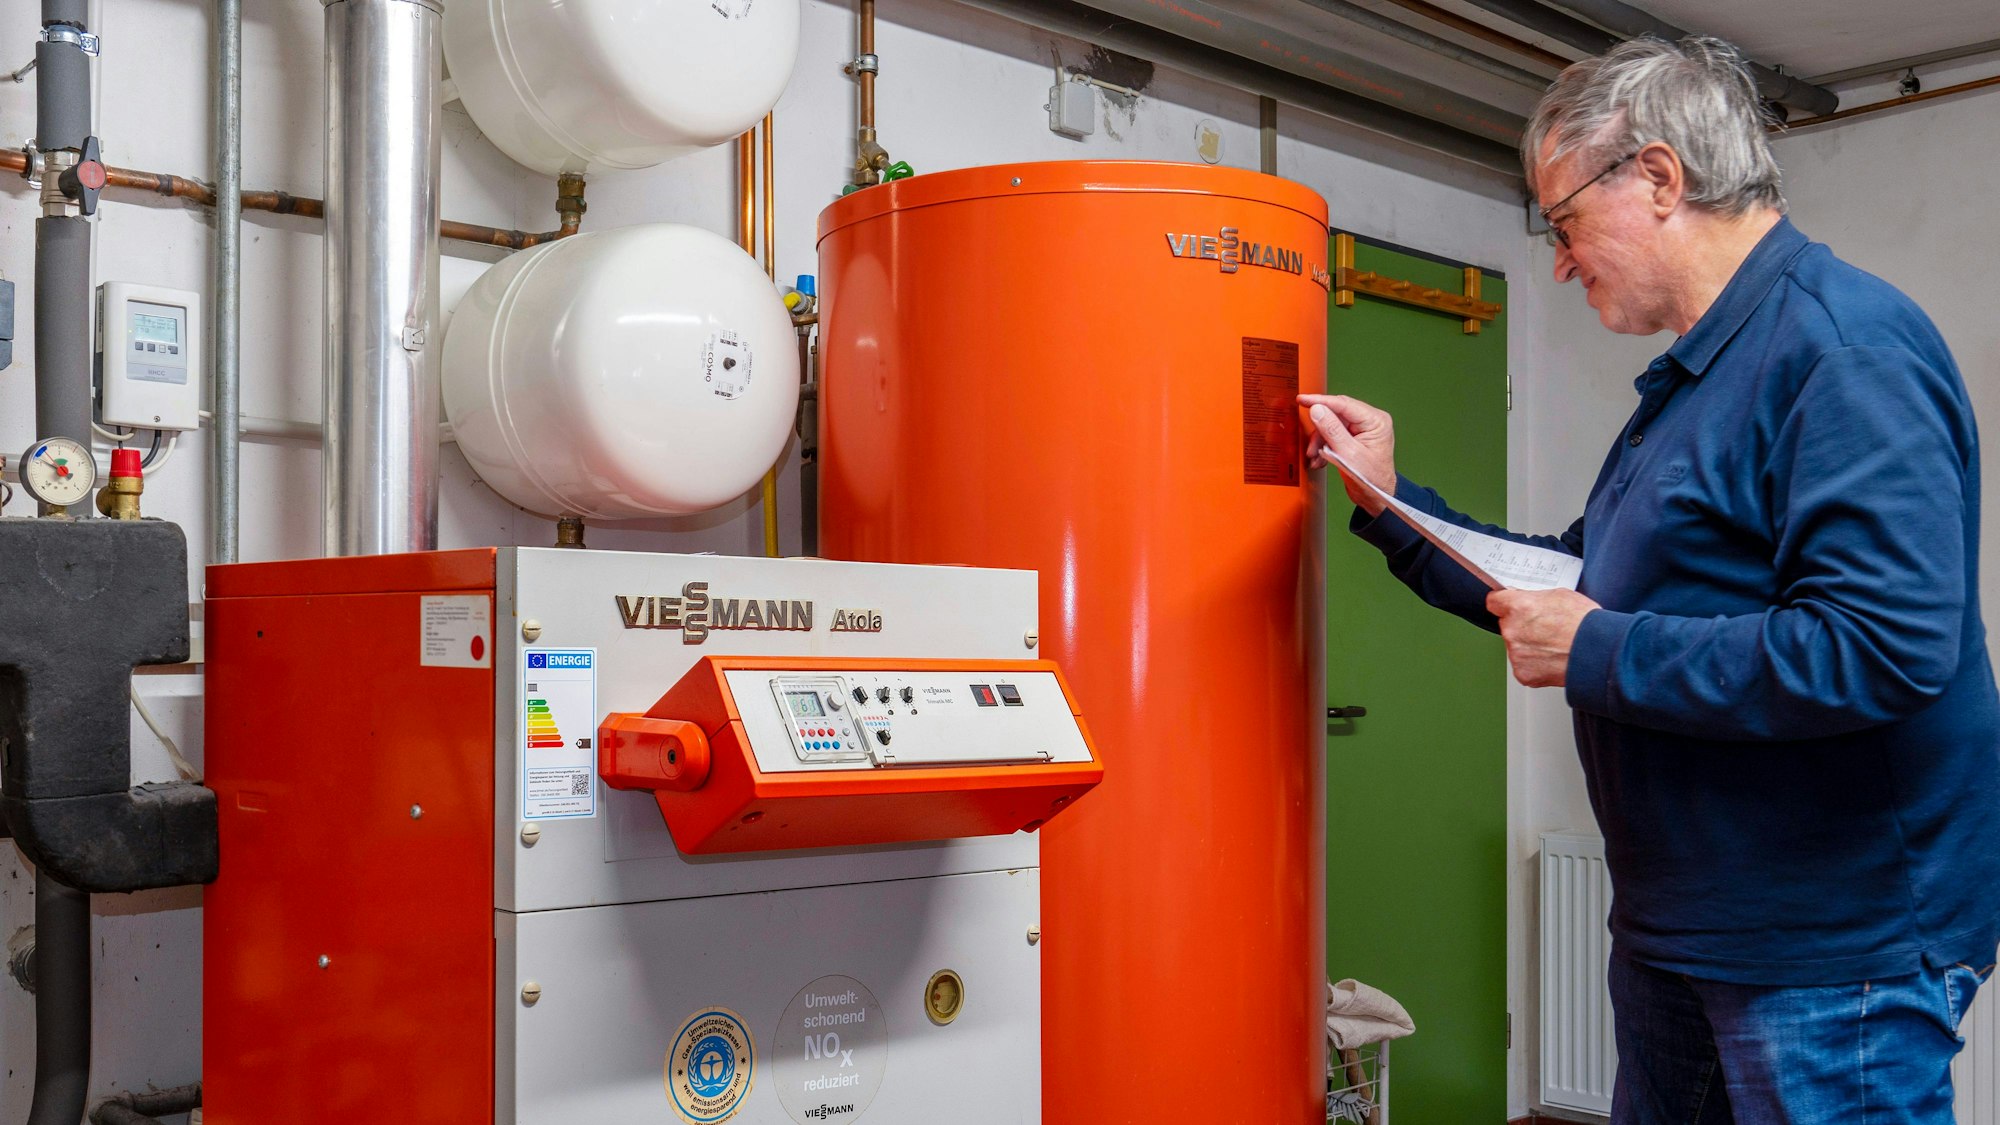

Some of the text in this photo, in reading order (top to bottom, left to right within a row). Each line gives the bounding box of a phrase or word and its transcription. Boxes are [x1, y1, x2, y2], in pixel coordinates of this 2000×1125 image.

[1165, 226, 1304, 275] VIESSMANN
[705, 352, 714, 382] COSMO
[615, 581, 884, 645] VIESSMANN Atola
[549, 655, 591, 666] ENERGIE
[921, 686, 951, 696] VIESSMANN
[805, 990, 858, 1008] Umwelt-
[688, 1018, 734, 1038] Umweltzeichen
[804, 1008, 865, 1028] schonend
[682, 1026, 741, 1059] Gas-Spezialheizkessel
[683, 1072, 741, 1106] weil emissionsarm und
[804, 1073, 860, 1091] reduziert
[690, 1094, 737, 1115] energiesparend
[804, 1104, 854, 1120] VIESSMANN
